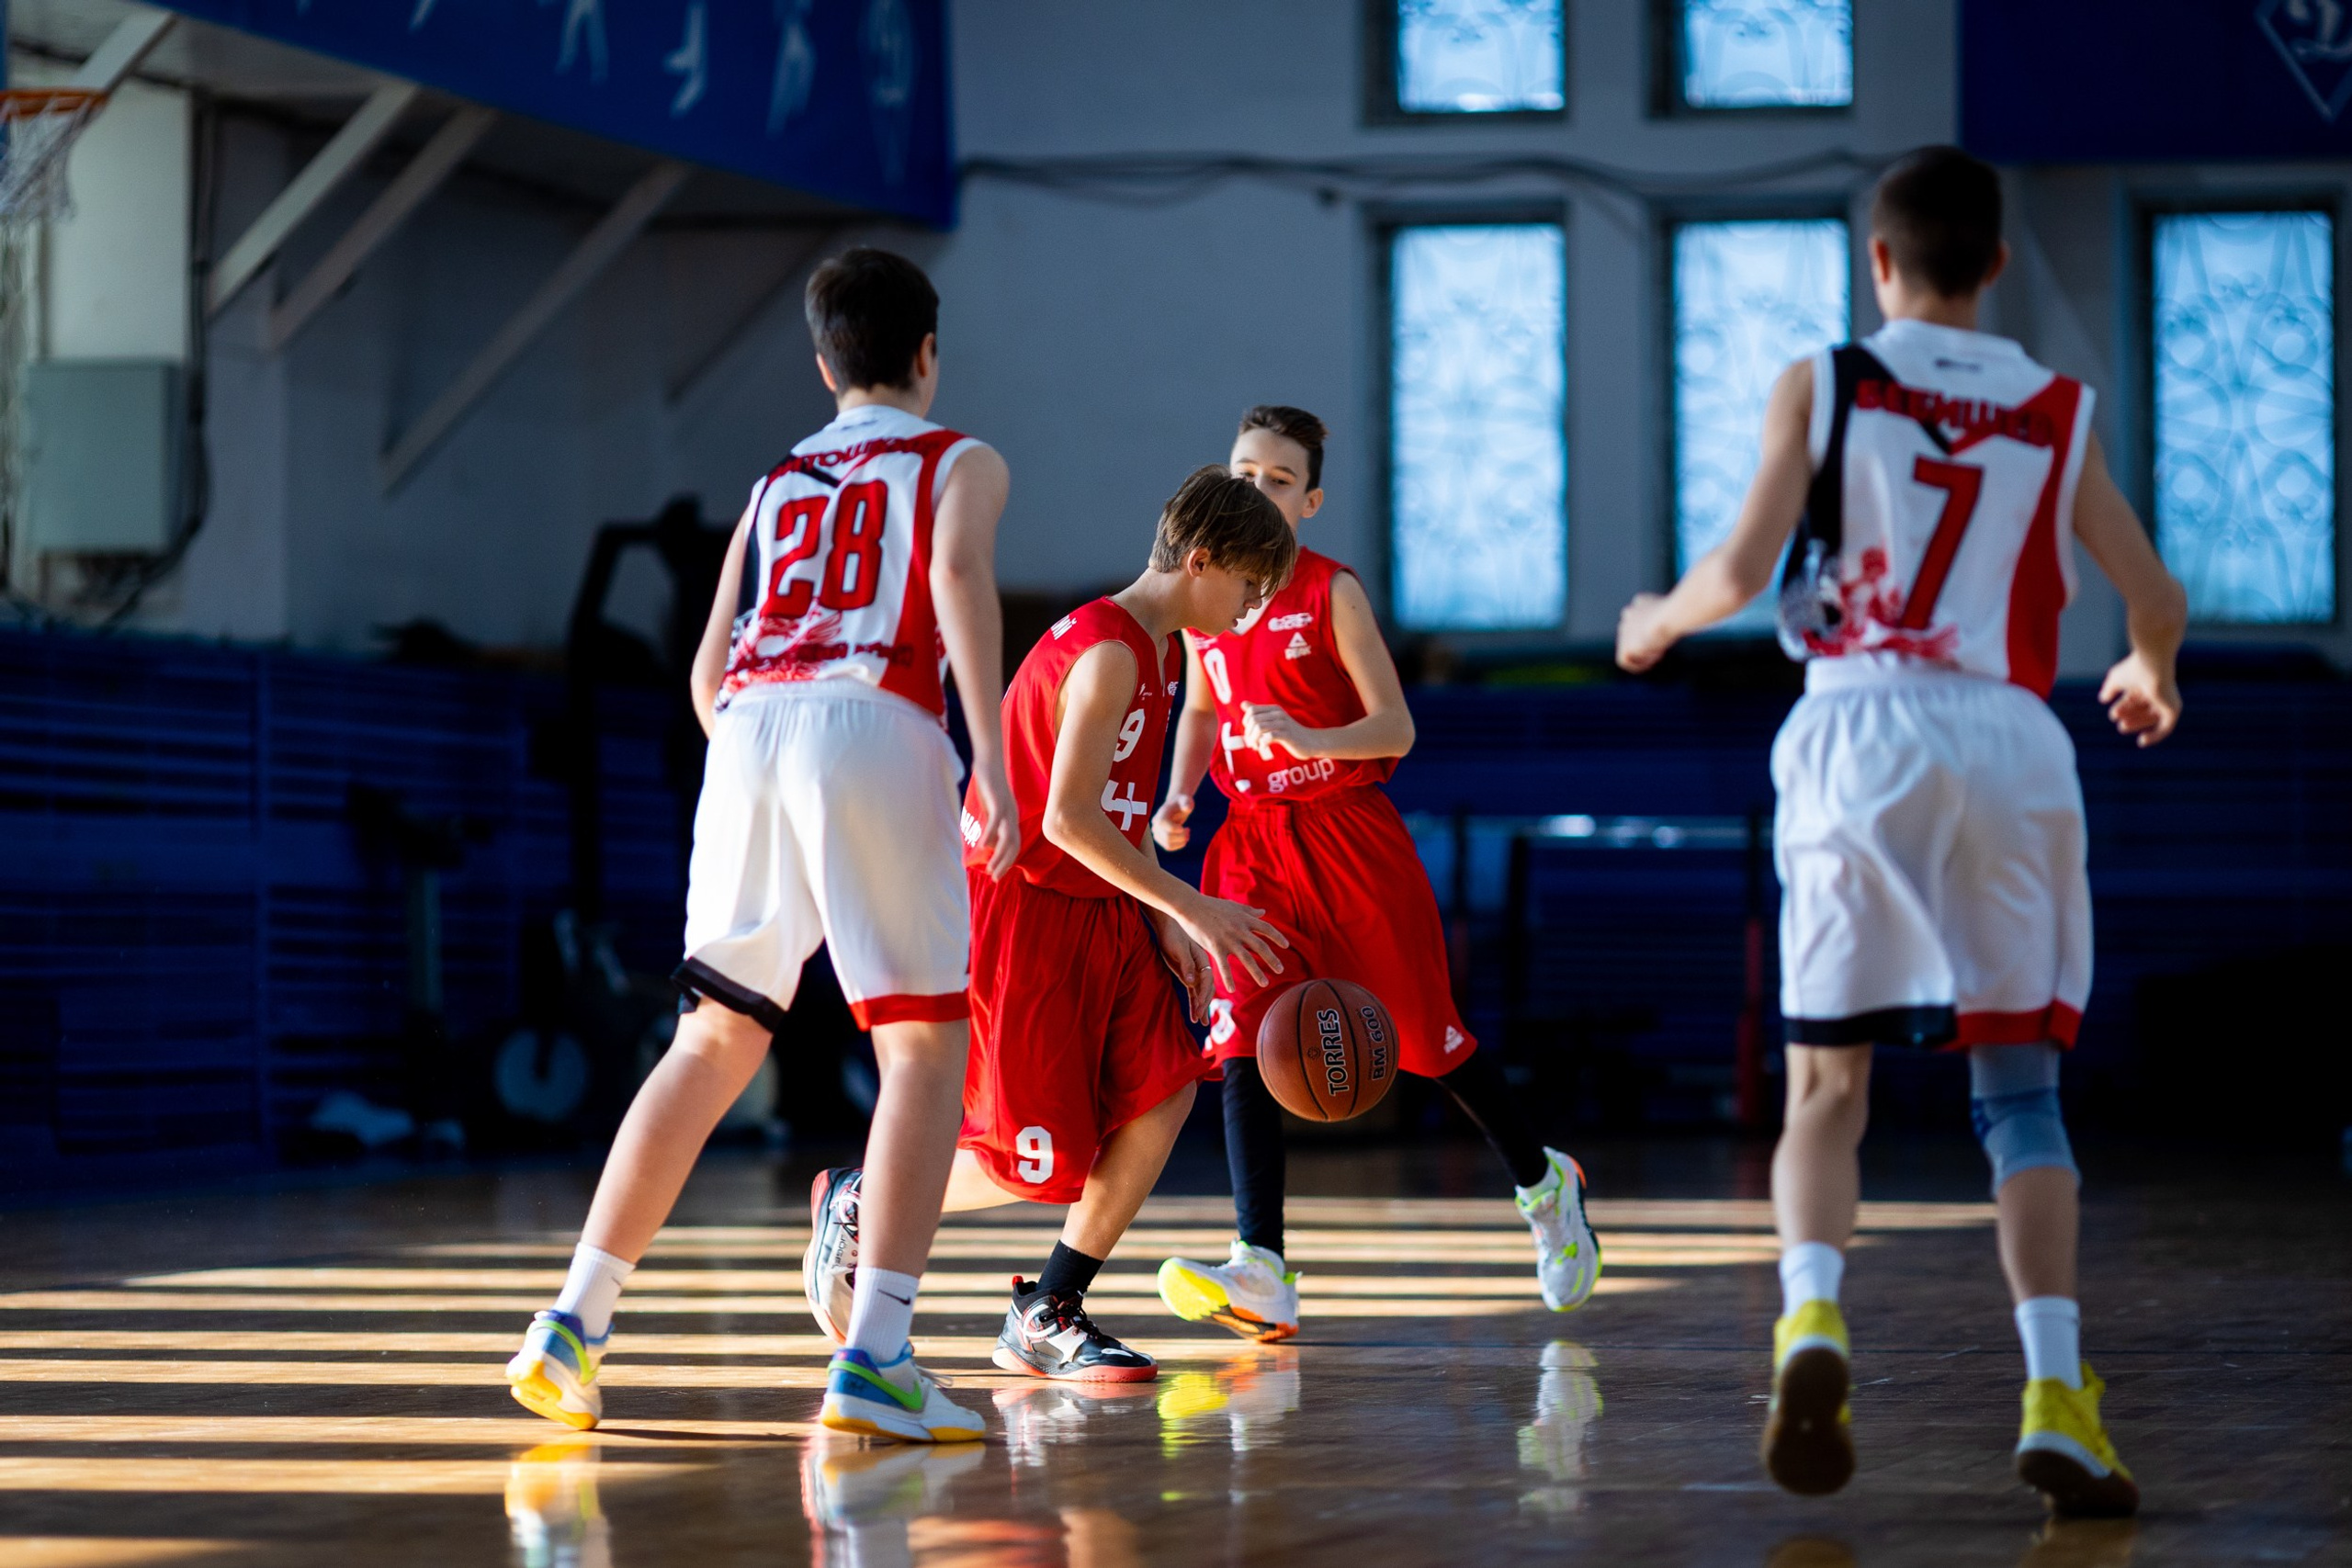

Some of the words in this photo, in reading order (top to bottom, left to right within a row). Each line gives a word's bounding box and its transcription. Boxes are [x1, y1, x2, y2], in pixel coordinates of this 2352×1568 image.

[759, 479, 888, 619] 28
[1900, 456, 1984, 630] 7
[1114, 708, 1146, 761] 9
[1267, 758, 1335, 794] group
[1361, 1005, 1385, 1043] 600
[1317, 1008, 1350, 1097] TORRES
[1372, 1045, 1386, 1080] BM
[1015, 1125, 1054, 1184] 9
